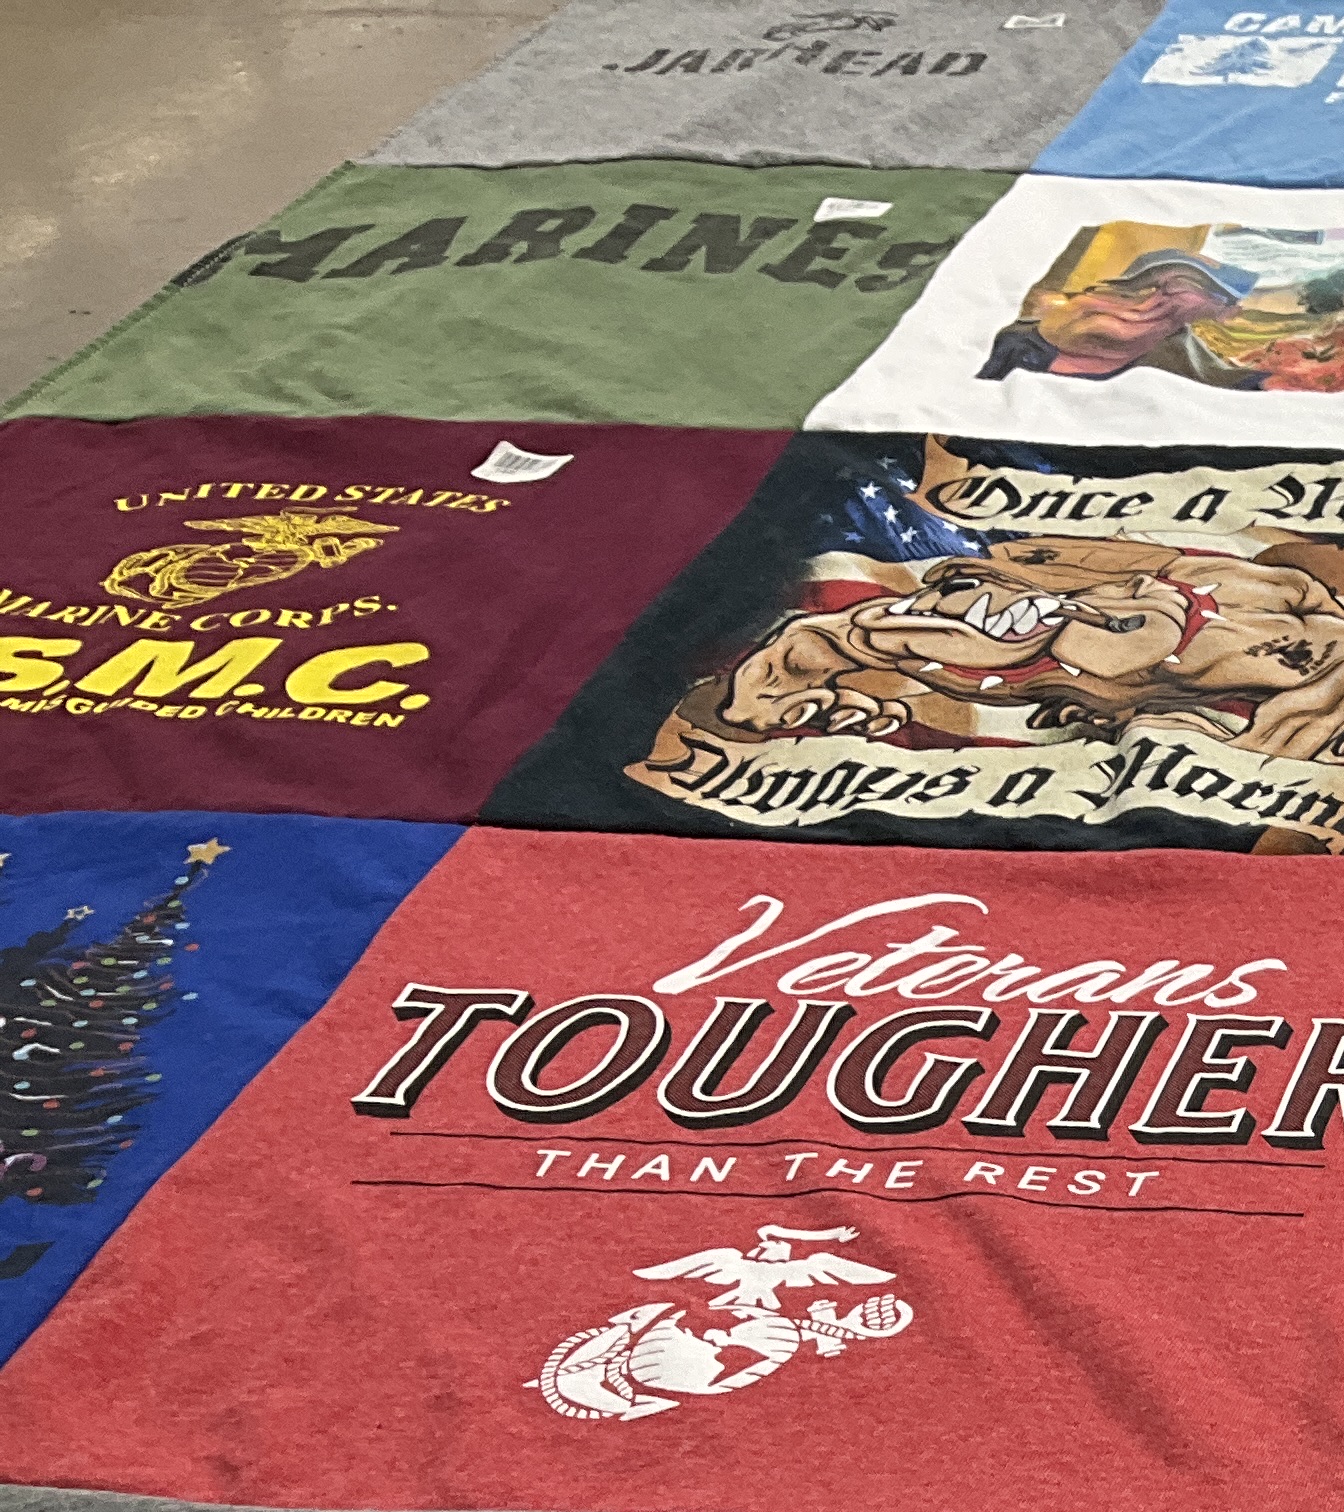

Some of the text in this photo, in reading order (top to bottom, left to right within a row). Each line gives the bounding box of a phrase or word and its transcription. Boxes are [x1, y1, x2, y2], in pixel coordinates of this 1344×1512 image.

[170, 203, 936, 293] MARINES
[113, 482, 512, 514] UNITED STATES
[928, 468, 1148, 522] Once
[1171, 486, 1222, 521] a
[189, 595, 398, 632] CORPS.
[215, 699, 405, 729] CHILDREN
[998, 777, 1041, 811] a
[652, 893, 1288, 1008] Veterans
[535, 1149, 1161, 1198] THAN THE REST
